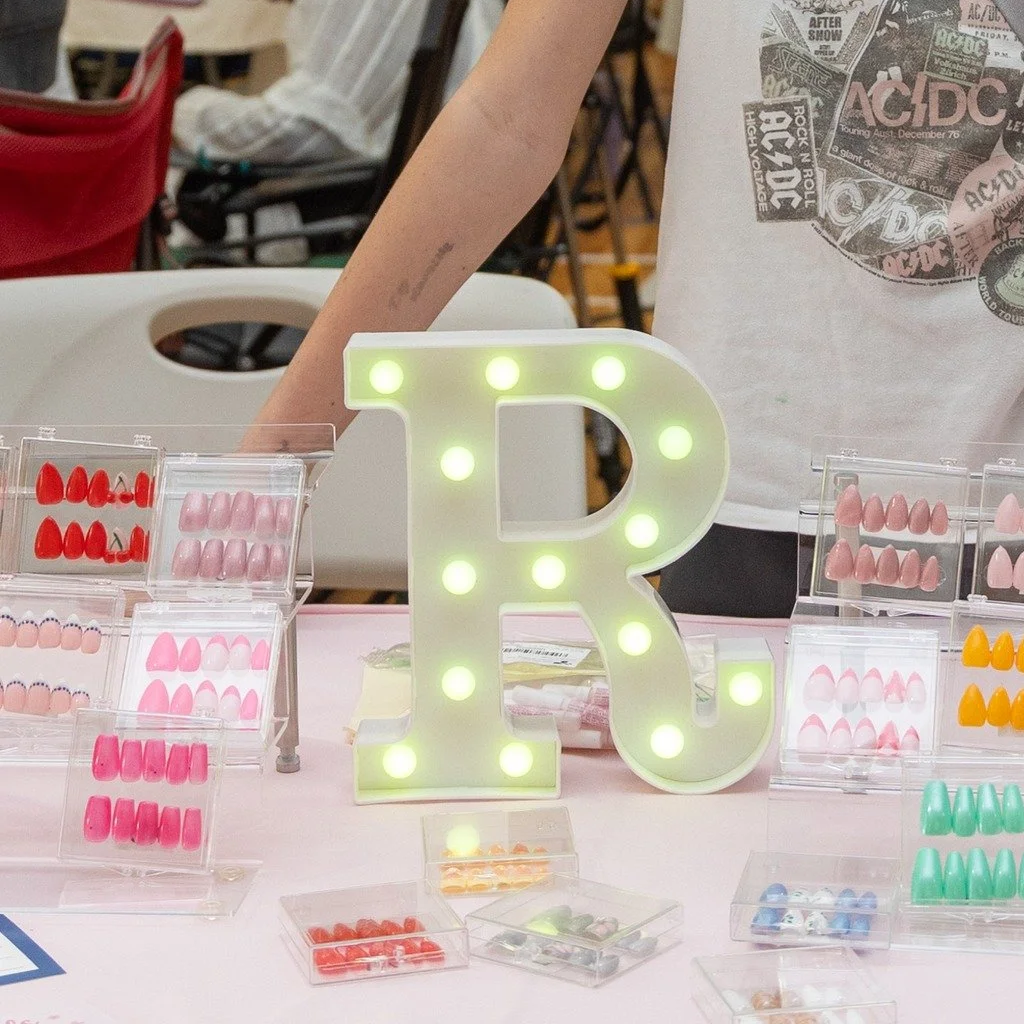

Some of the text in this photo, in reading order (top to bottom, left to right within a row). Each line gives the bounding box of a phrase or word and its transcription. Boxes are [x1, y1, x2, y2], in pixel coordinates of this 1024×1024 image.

[809, 17, 842, 28] AFTER
[808, 29, 843, 41] SHOW
[840, 124, 871, 138] Touring
[898, 129, 945, 139] December
[745, 111, 768, 212] HIGH VOLTAGE
[793, 105, 809, 147] ROCK
[802, 168, 816, 209] ROLL
[840, 147, 863, 163] giant
[994, 238, 1022, 255] BACK
[979, 276, 997, 311] WORLD
